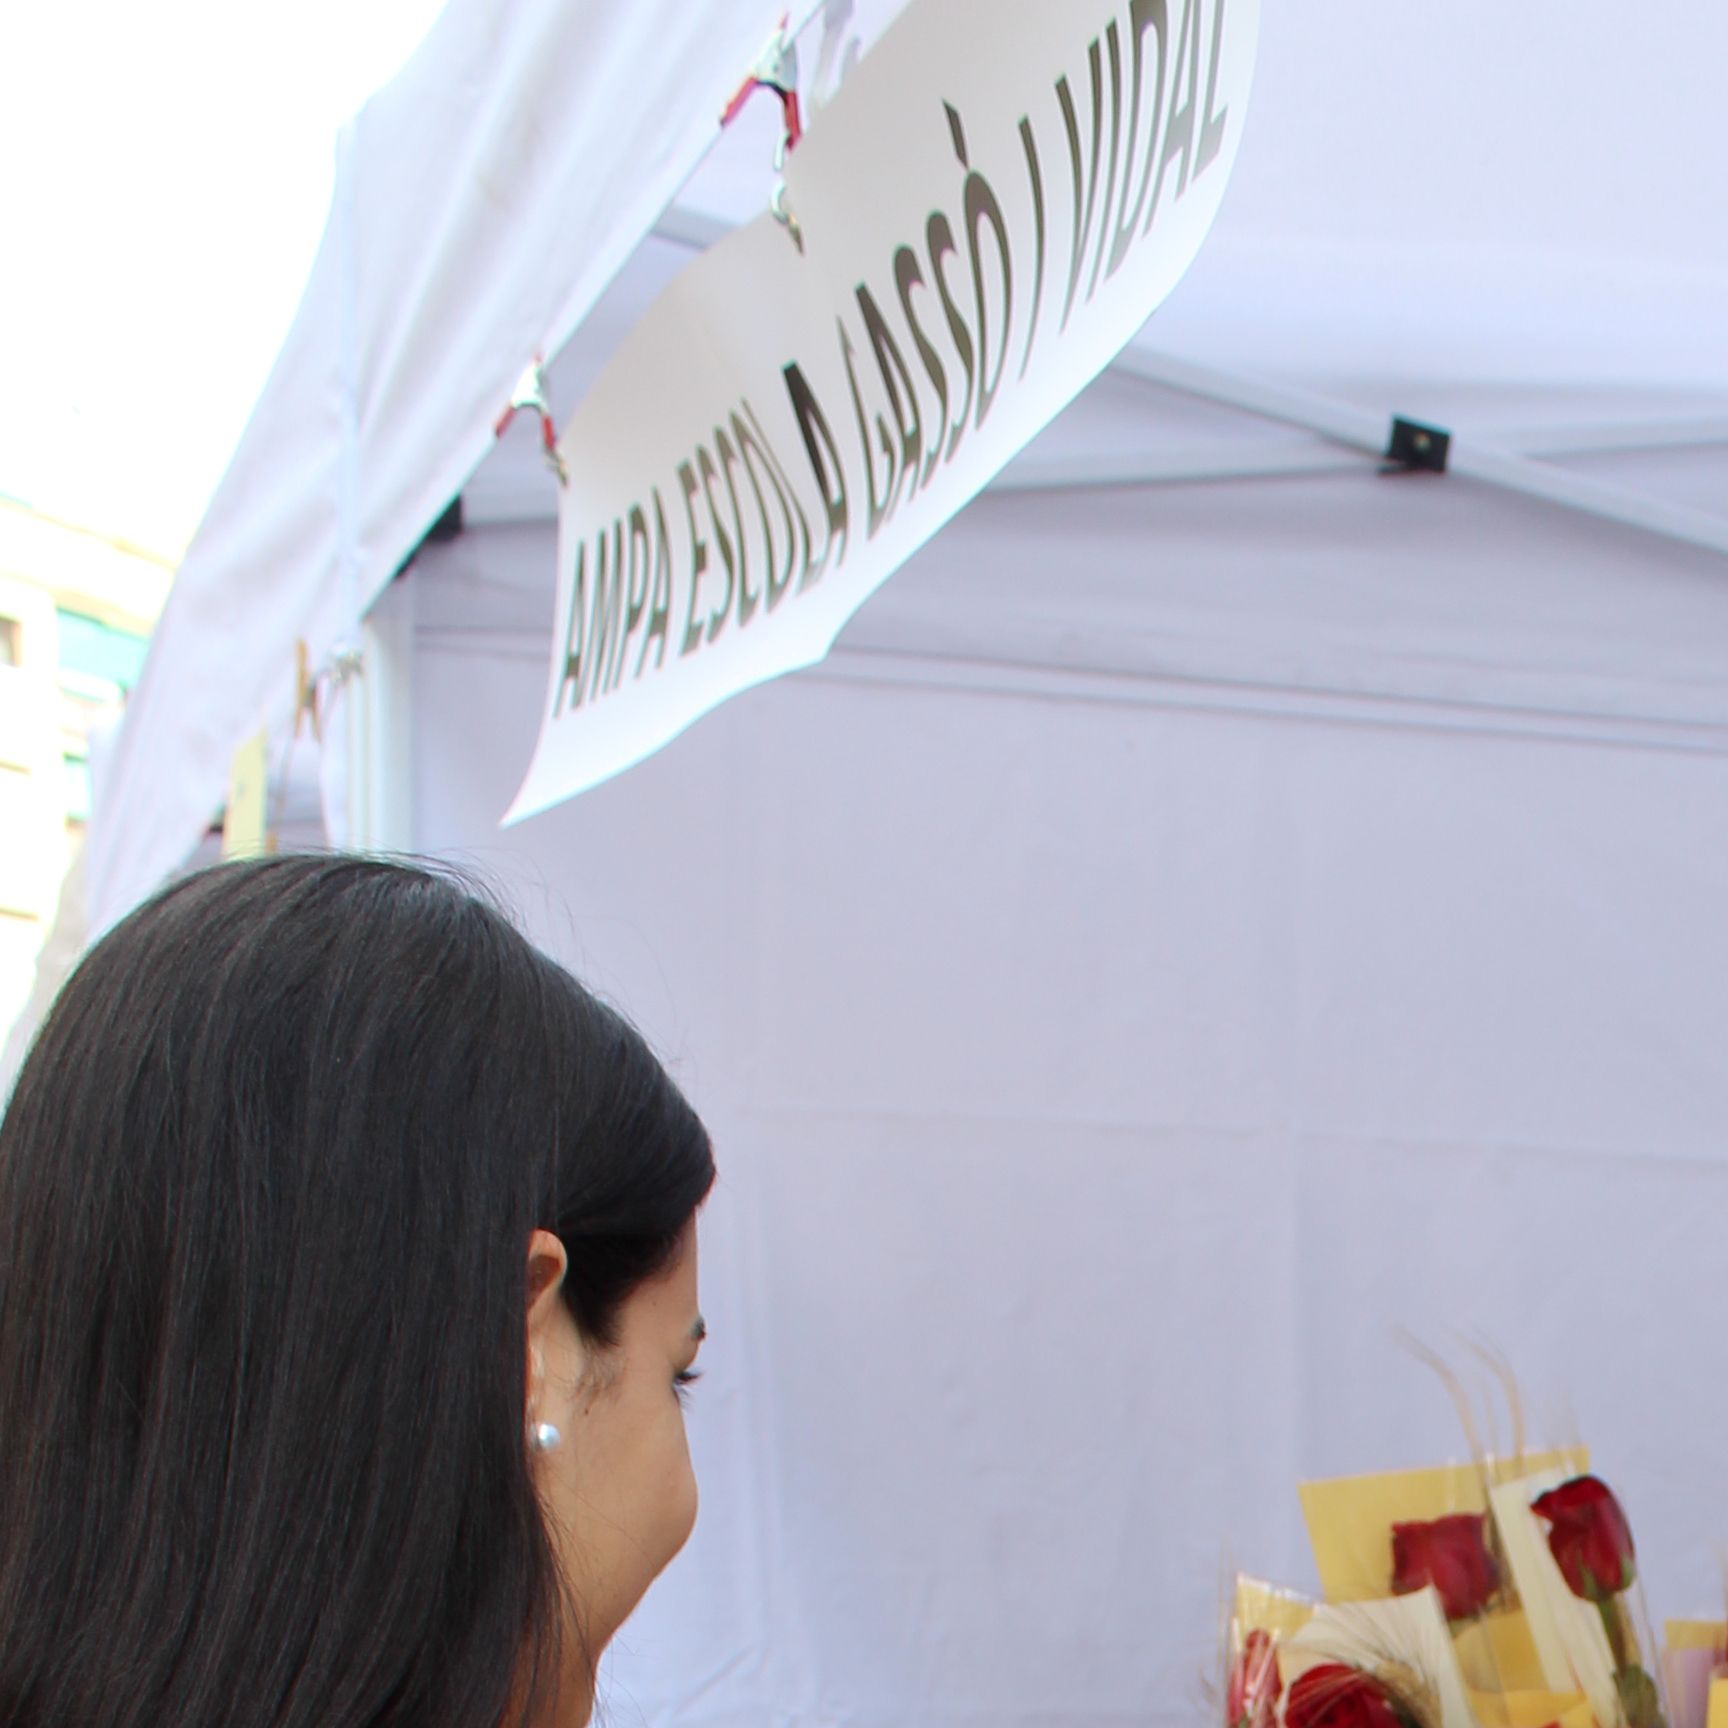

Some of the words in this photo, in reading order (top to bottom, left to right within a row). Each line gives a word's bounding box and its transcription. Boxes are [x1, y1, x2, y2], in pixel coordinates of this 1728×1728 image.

[553, 486, 671, 719] AMPA
[676, 361, 849, 657] ESCOLA
[1018, 114, 1044, 383] I
[1055, 0, 1229, 337] VIDAL
